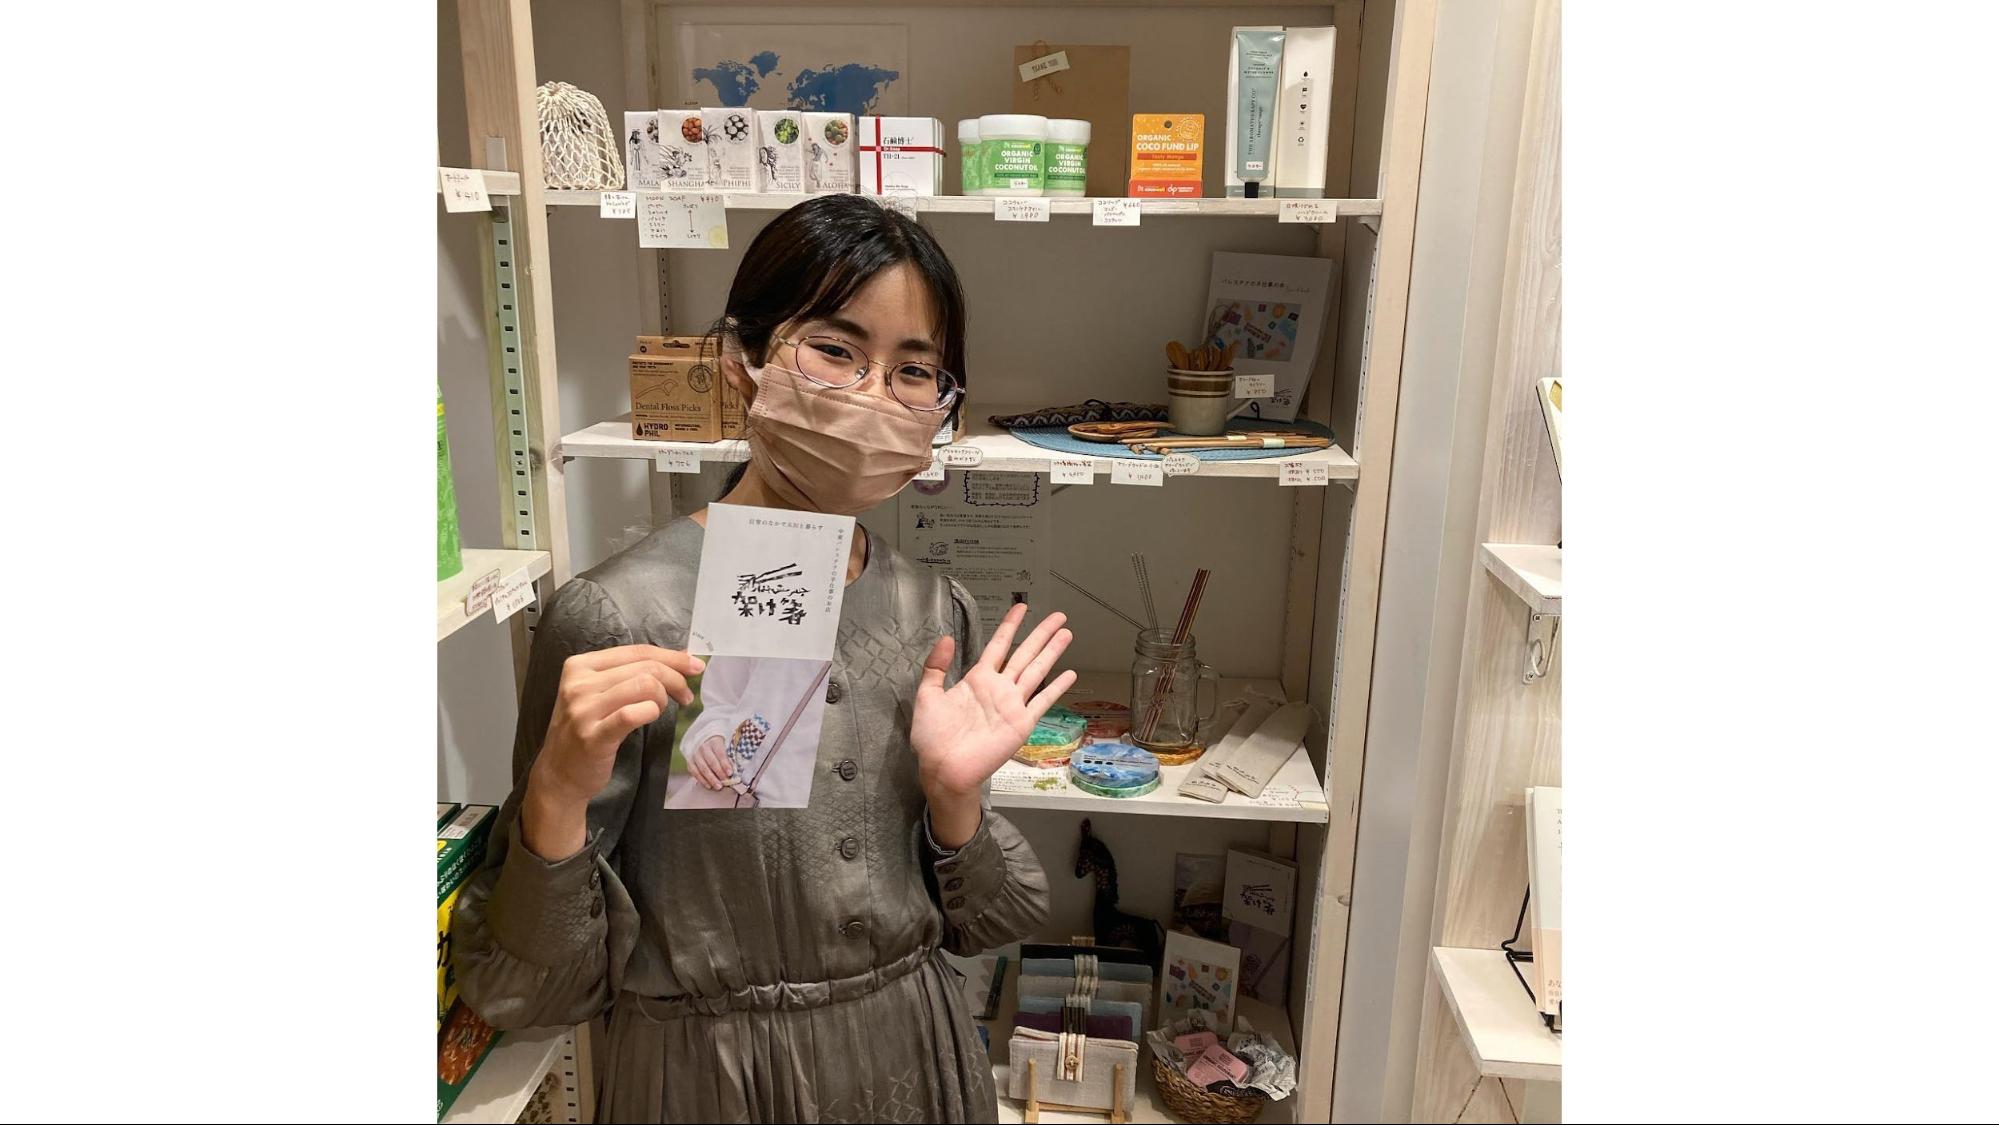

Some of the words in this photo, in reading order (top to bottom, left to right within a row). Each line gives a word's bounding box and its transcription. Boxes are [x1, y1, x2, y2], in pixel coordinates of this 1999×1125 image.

[1136, 142, 1161, 151] COCO
[1162, 142, 1185, 151] FUND
[1186, 143, 1199, 151] LIP
[1001, 150, 1034, 158] ORGANIC
[995, 163, 1028, 171] COCONUT
[776, 182, 800, 190] SICILY
[635, 402, 659, 410] Dental
[661, 403, 680, 411] Floss
[681, 403, 701, 412] Picks
[643, 423, 669, 431] HYDRO
